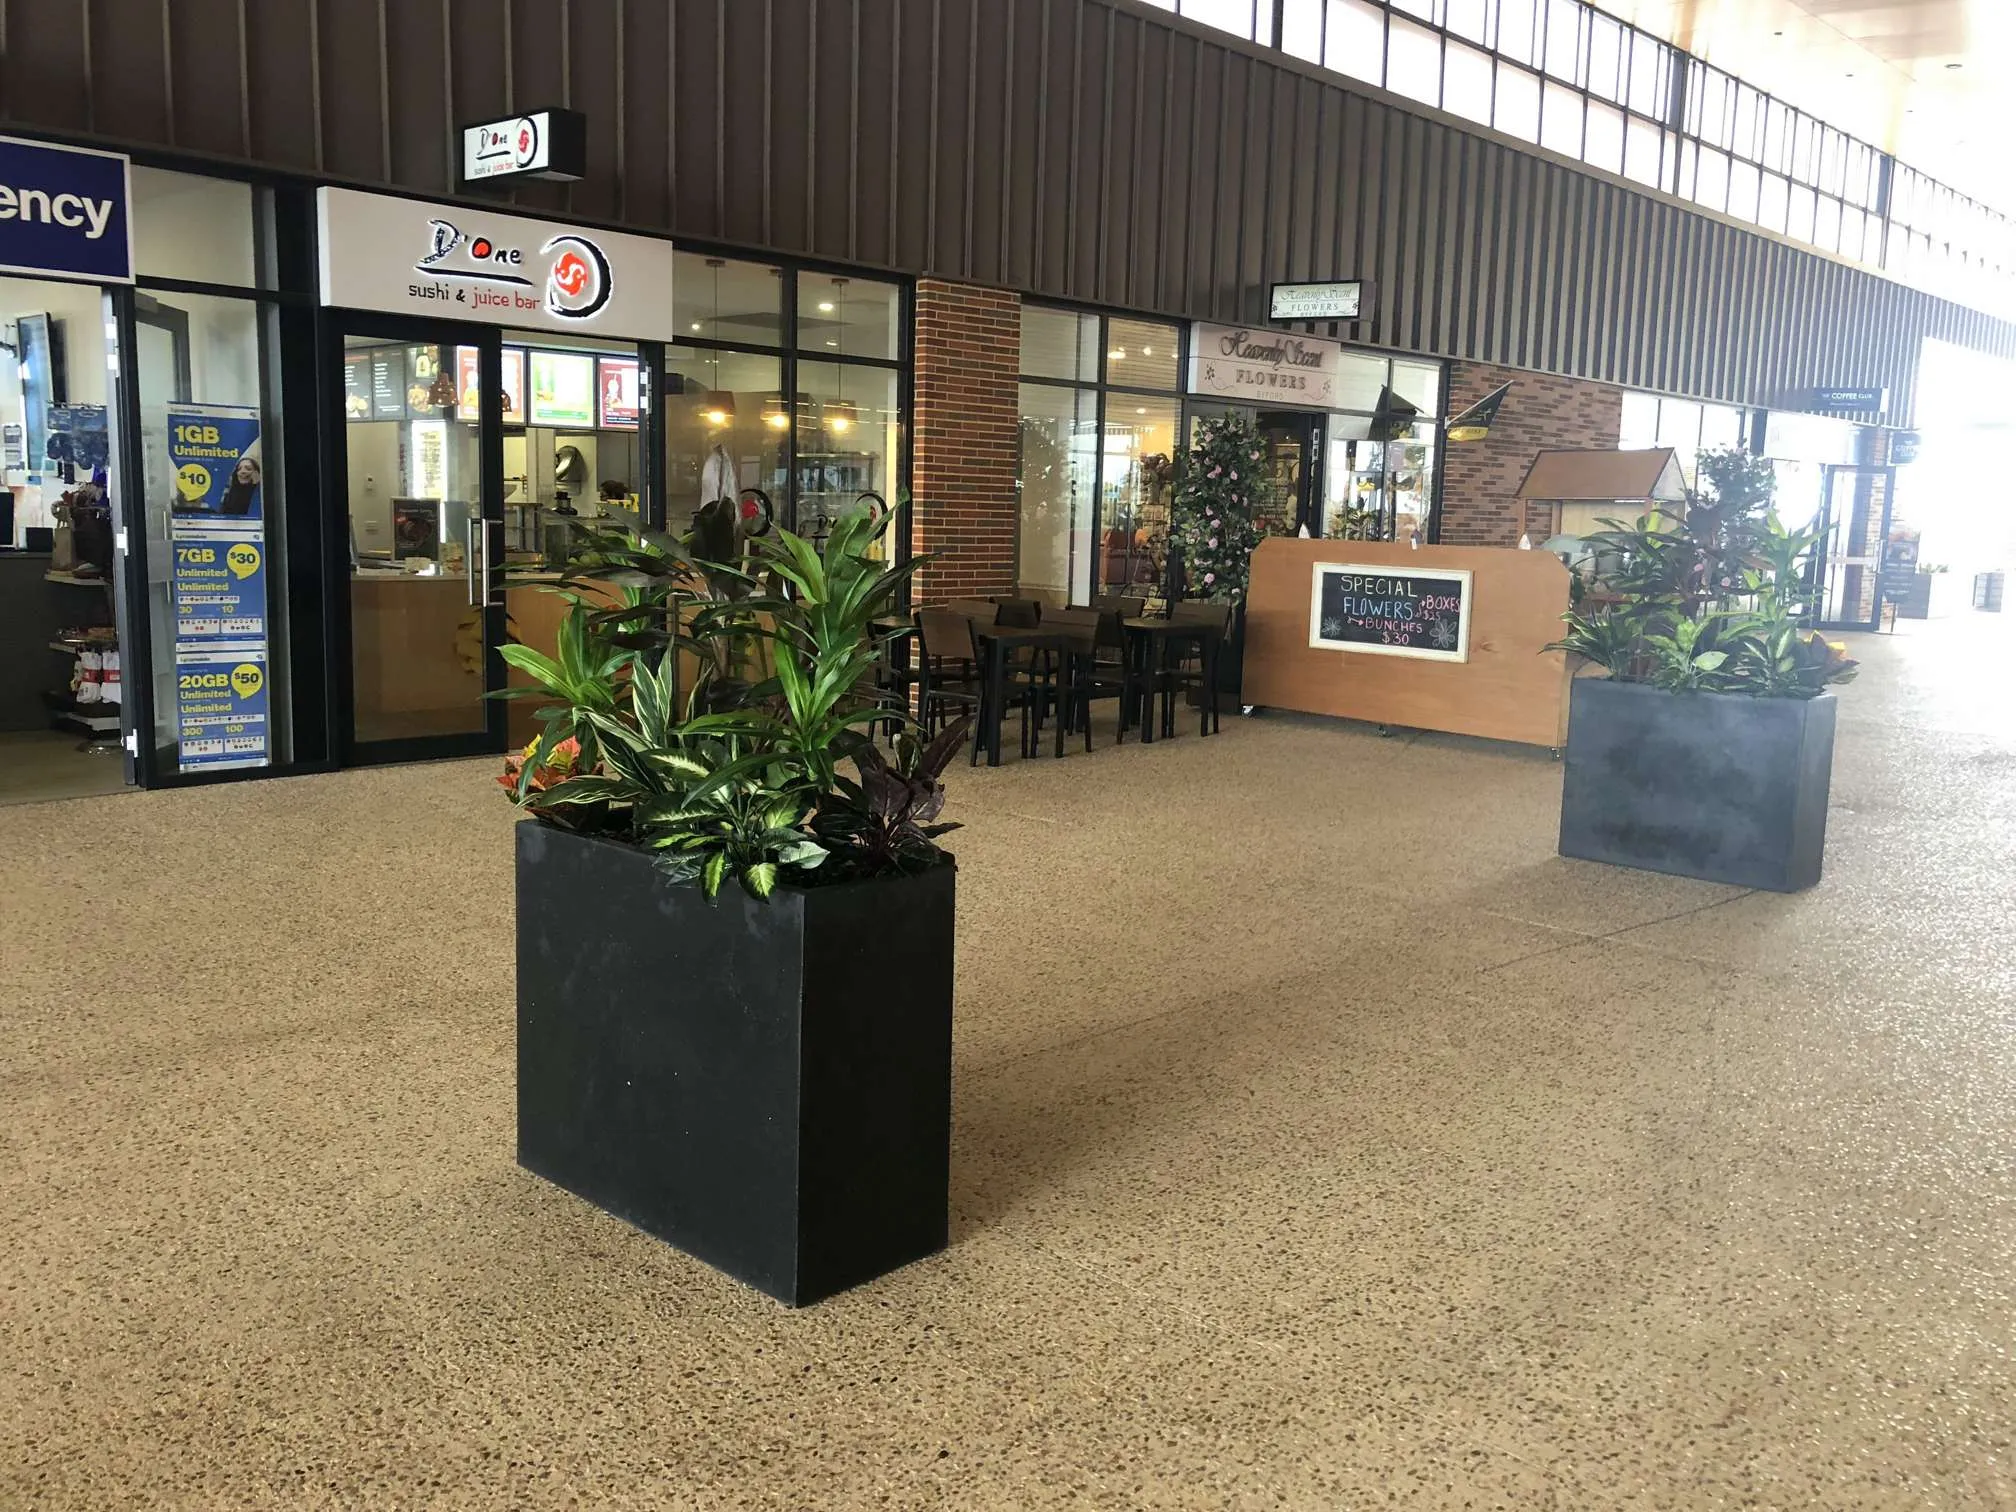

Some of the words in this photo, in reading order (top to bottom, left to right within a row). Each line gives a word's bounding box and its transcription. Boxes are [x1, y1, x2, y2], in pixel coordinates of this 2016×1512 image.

[408, 283, 449, 301] sushi
[456, 289, 466, 302] &
[472, 287, 510, 309] juice
[515, 292, 541, 309] bar
[1291, 302, 1338, 312] FLOWERS
[1220, 331, 1285, 371] Heavenly
[1236, 369, 1306, 390] FLOWERS
[1832, 392, 1857, 400] COFFEE
[174, 425, 220, 444] 1GB
[174, 445, 239, 458] Unlimited
[180, 471, 206, 485] $10
[176, 548, 216, 563] 7GB
[230, 552, 256, 564] $30
[176, 568, 228, 577] Unlimited
[177, 582, 229, 592] Unlimited
[1341, 575, 1418, 598] SPECIAL
[178, 606, 192, 614] 30
[222, 605, 234, 613] 10
[1343, 596, 1413, 621] FLOWERS
[1426, 594, 1460, 613] BOXES
[1365, 616, 1423, 633] BUNCHES
[179, 674, 229, 689] 20GB
[234, 673, 259, 684] $50
[180, 689, 232, 700] Unlimited
[180, 703, 232, 713] Unlimited
[182, 727, 204, 736] 300
[225, 724, 244, 734] 100
